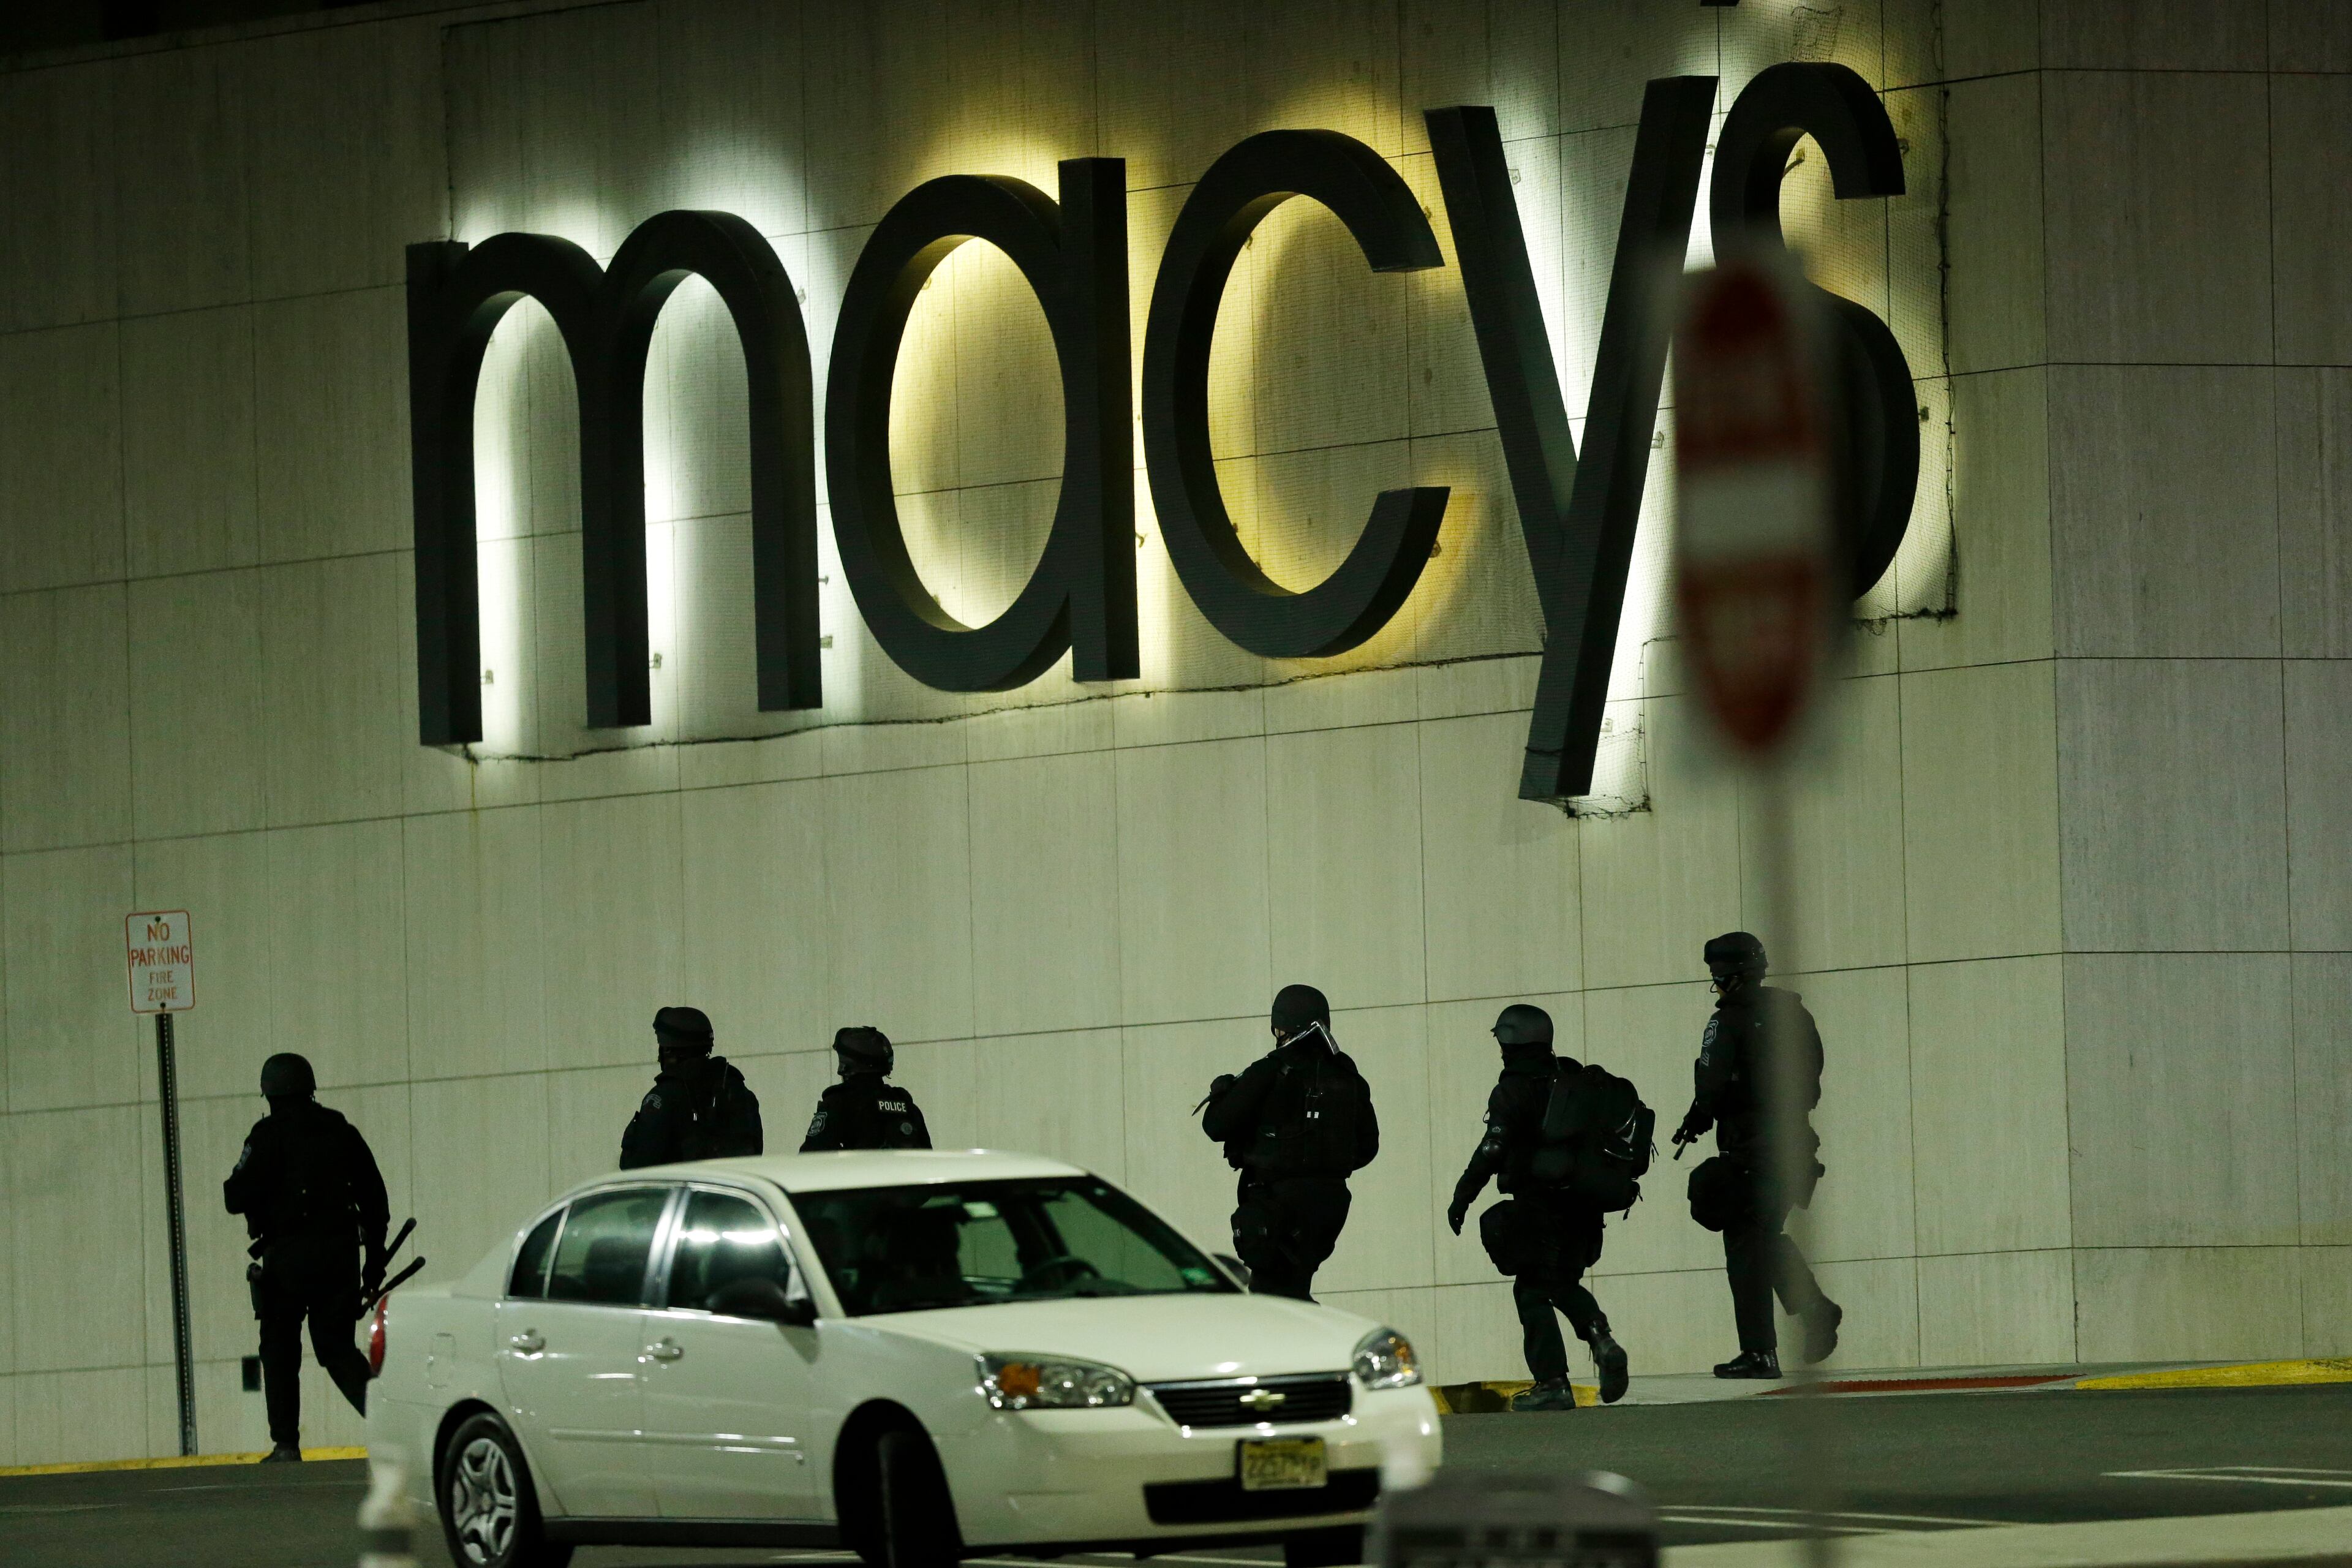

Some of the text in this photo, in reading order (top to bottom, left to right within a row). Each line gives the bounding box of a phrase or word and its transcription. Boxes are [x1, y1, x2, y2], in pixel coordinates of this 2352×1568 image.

[148, 924, 170, 941] NO
[130, 946, 189, 967] PARKING
[149, 971, 173, 984] FIRE
[148, 987, 177, 1001] ZONE
[878, 1101, 907, 1112] POLICE
